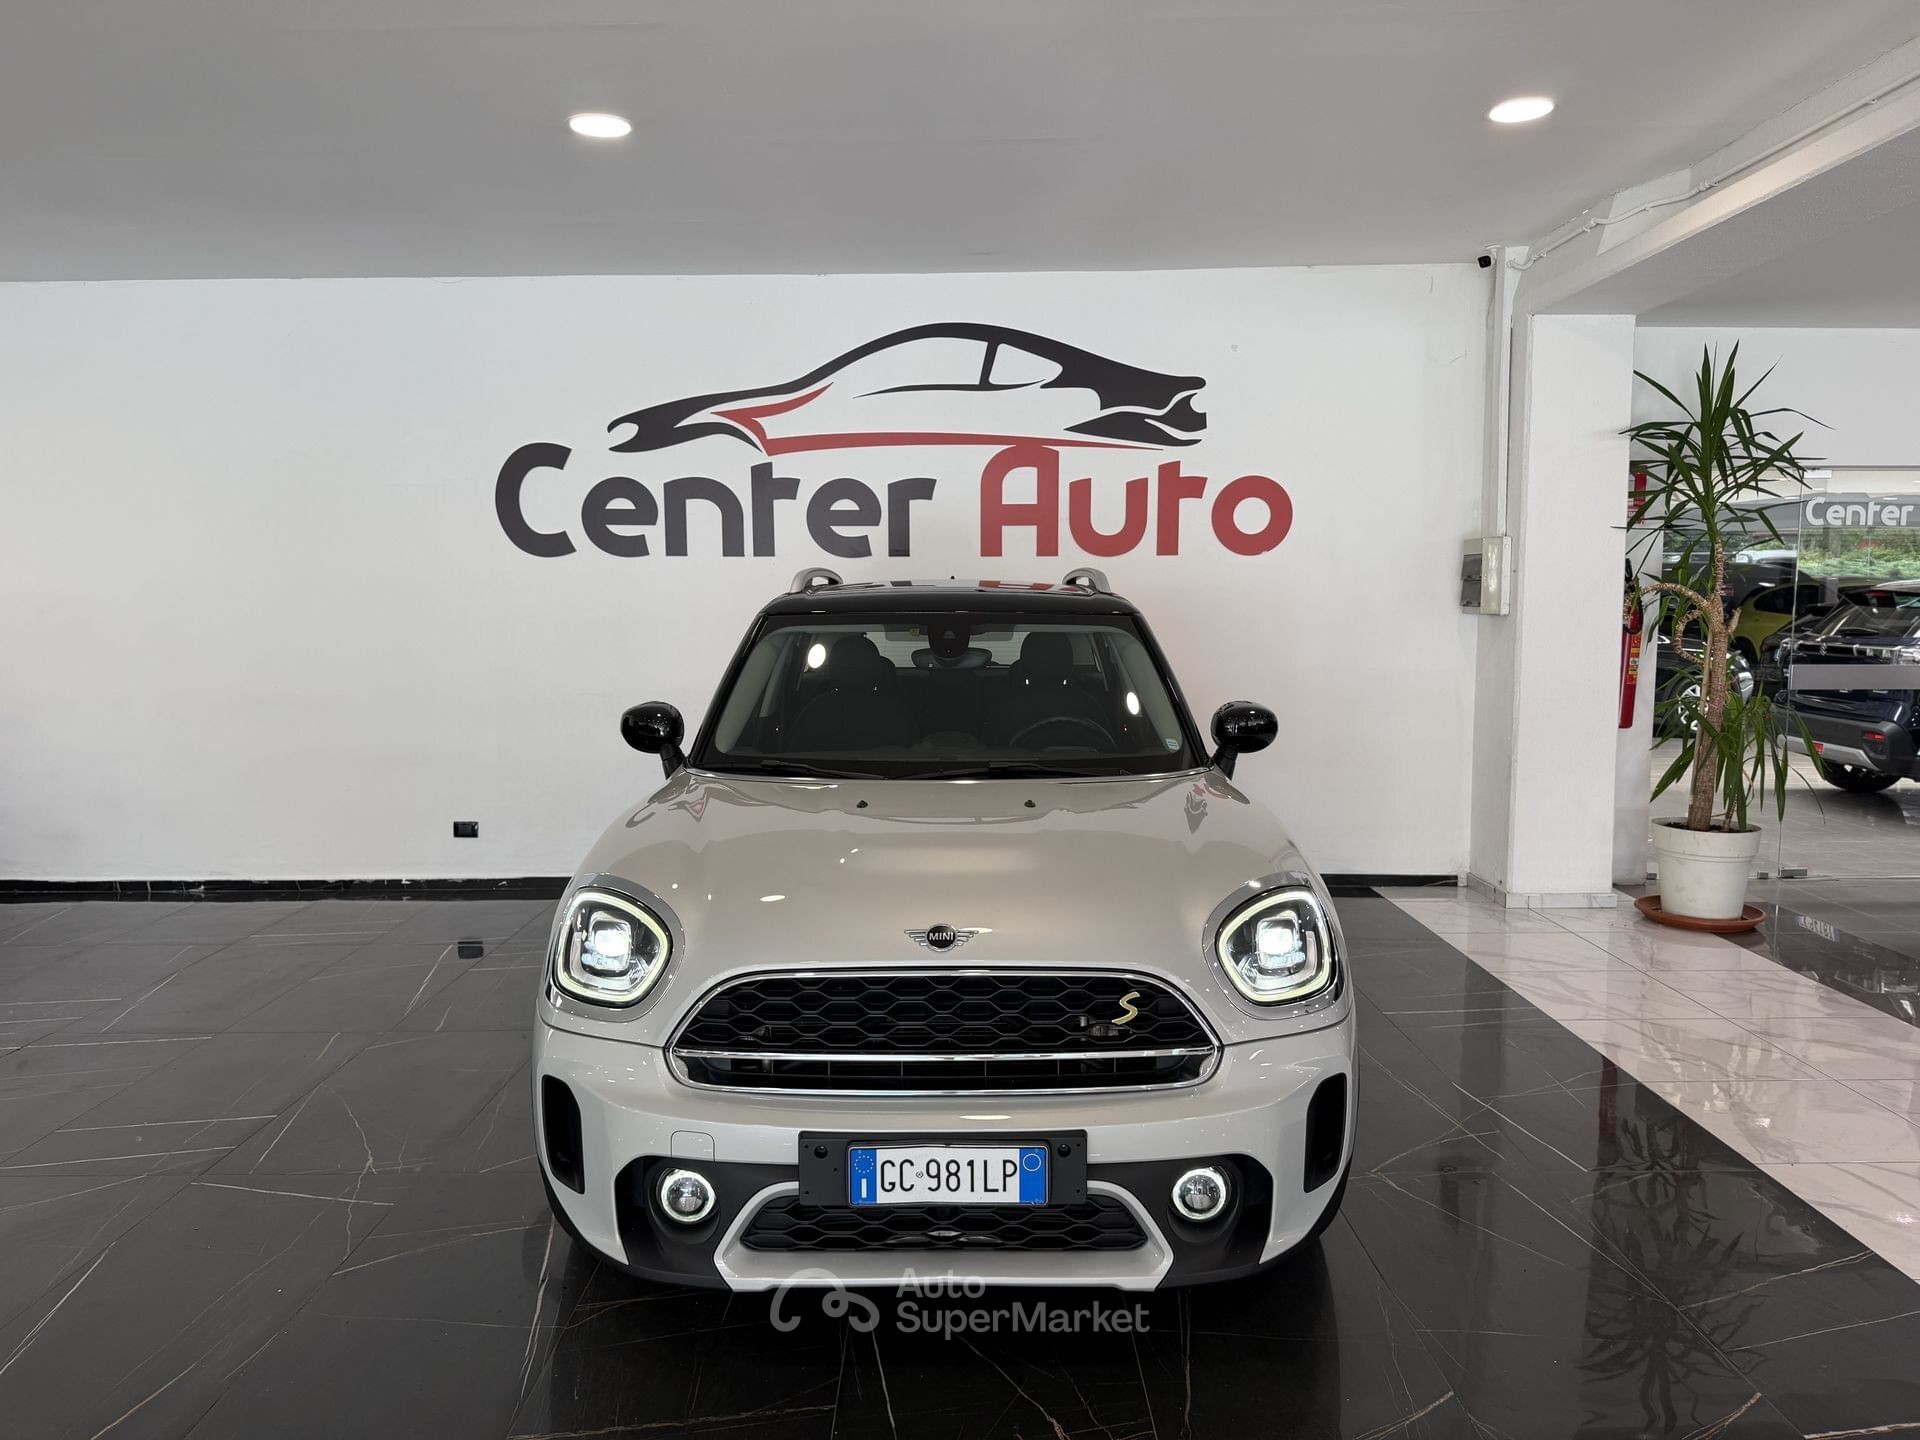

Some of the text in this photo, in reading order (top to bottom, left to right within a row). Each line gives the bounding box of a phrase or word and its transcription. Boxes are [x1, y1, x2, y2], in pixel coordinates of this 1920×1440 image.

[494, 442, 1294, 558] Center Auto
[1805, 496, 1914, 526] Center
[929, 932, 954, 941] MINI
[1111, 991, 1140, 1025] S
